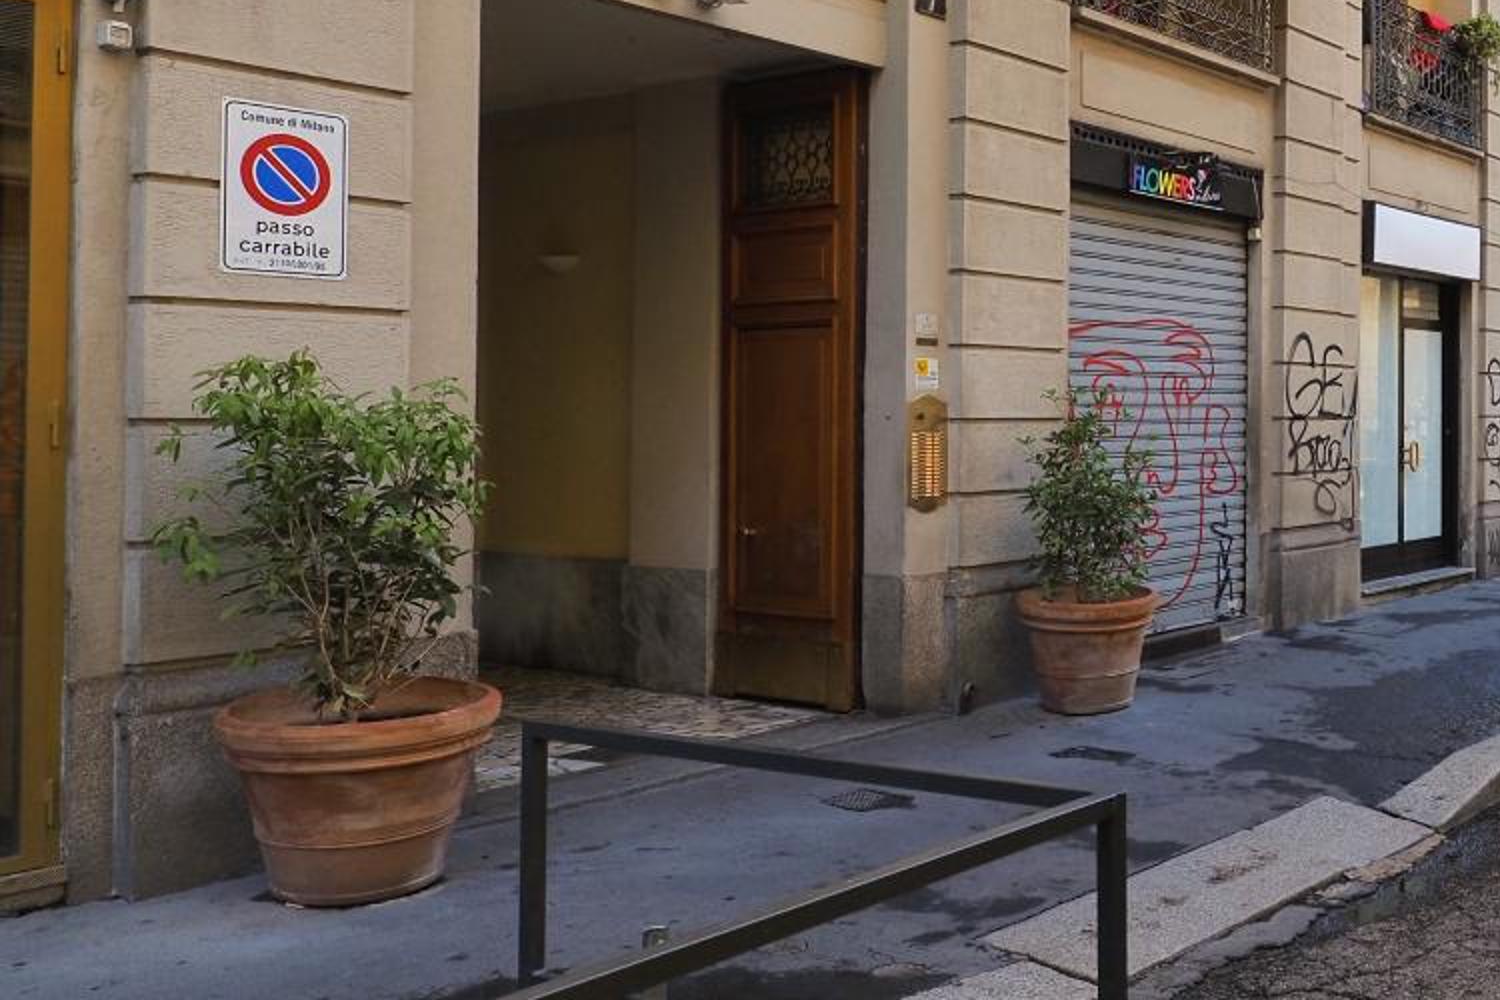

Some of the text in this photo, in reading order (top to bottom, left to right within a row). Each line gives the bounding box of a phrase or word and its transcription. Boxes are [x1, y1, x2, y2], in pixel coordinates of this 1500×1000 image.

[241, 109, 284, 127] Comune
[287, 117, 297, 128] di
[1133, 163, 1196, 200] FLOWERS
[256, 220, 315, 237] passo
[239, 239, 330, 258] carrabile
